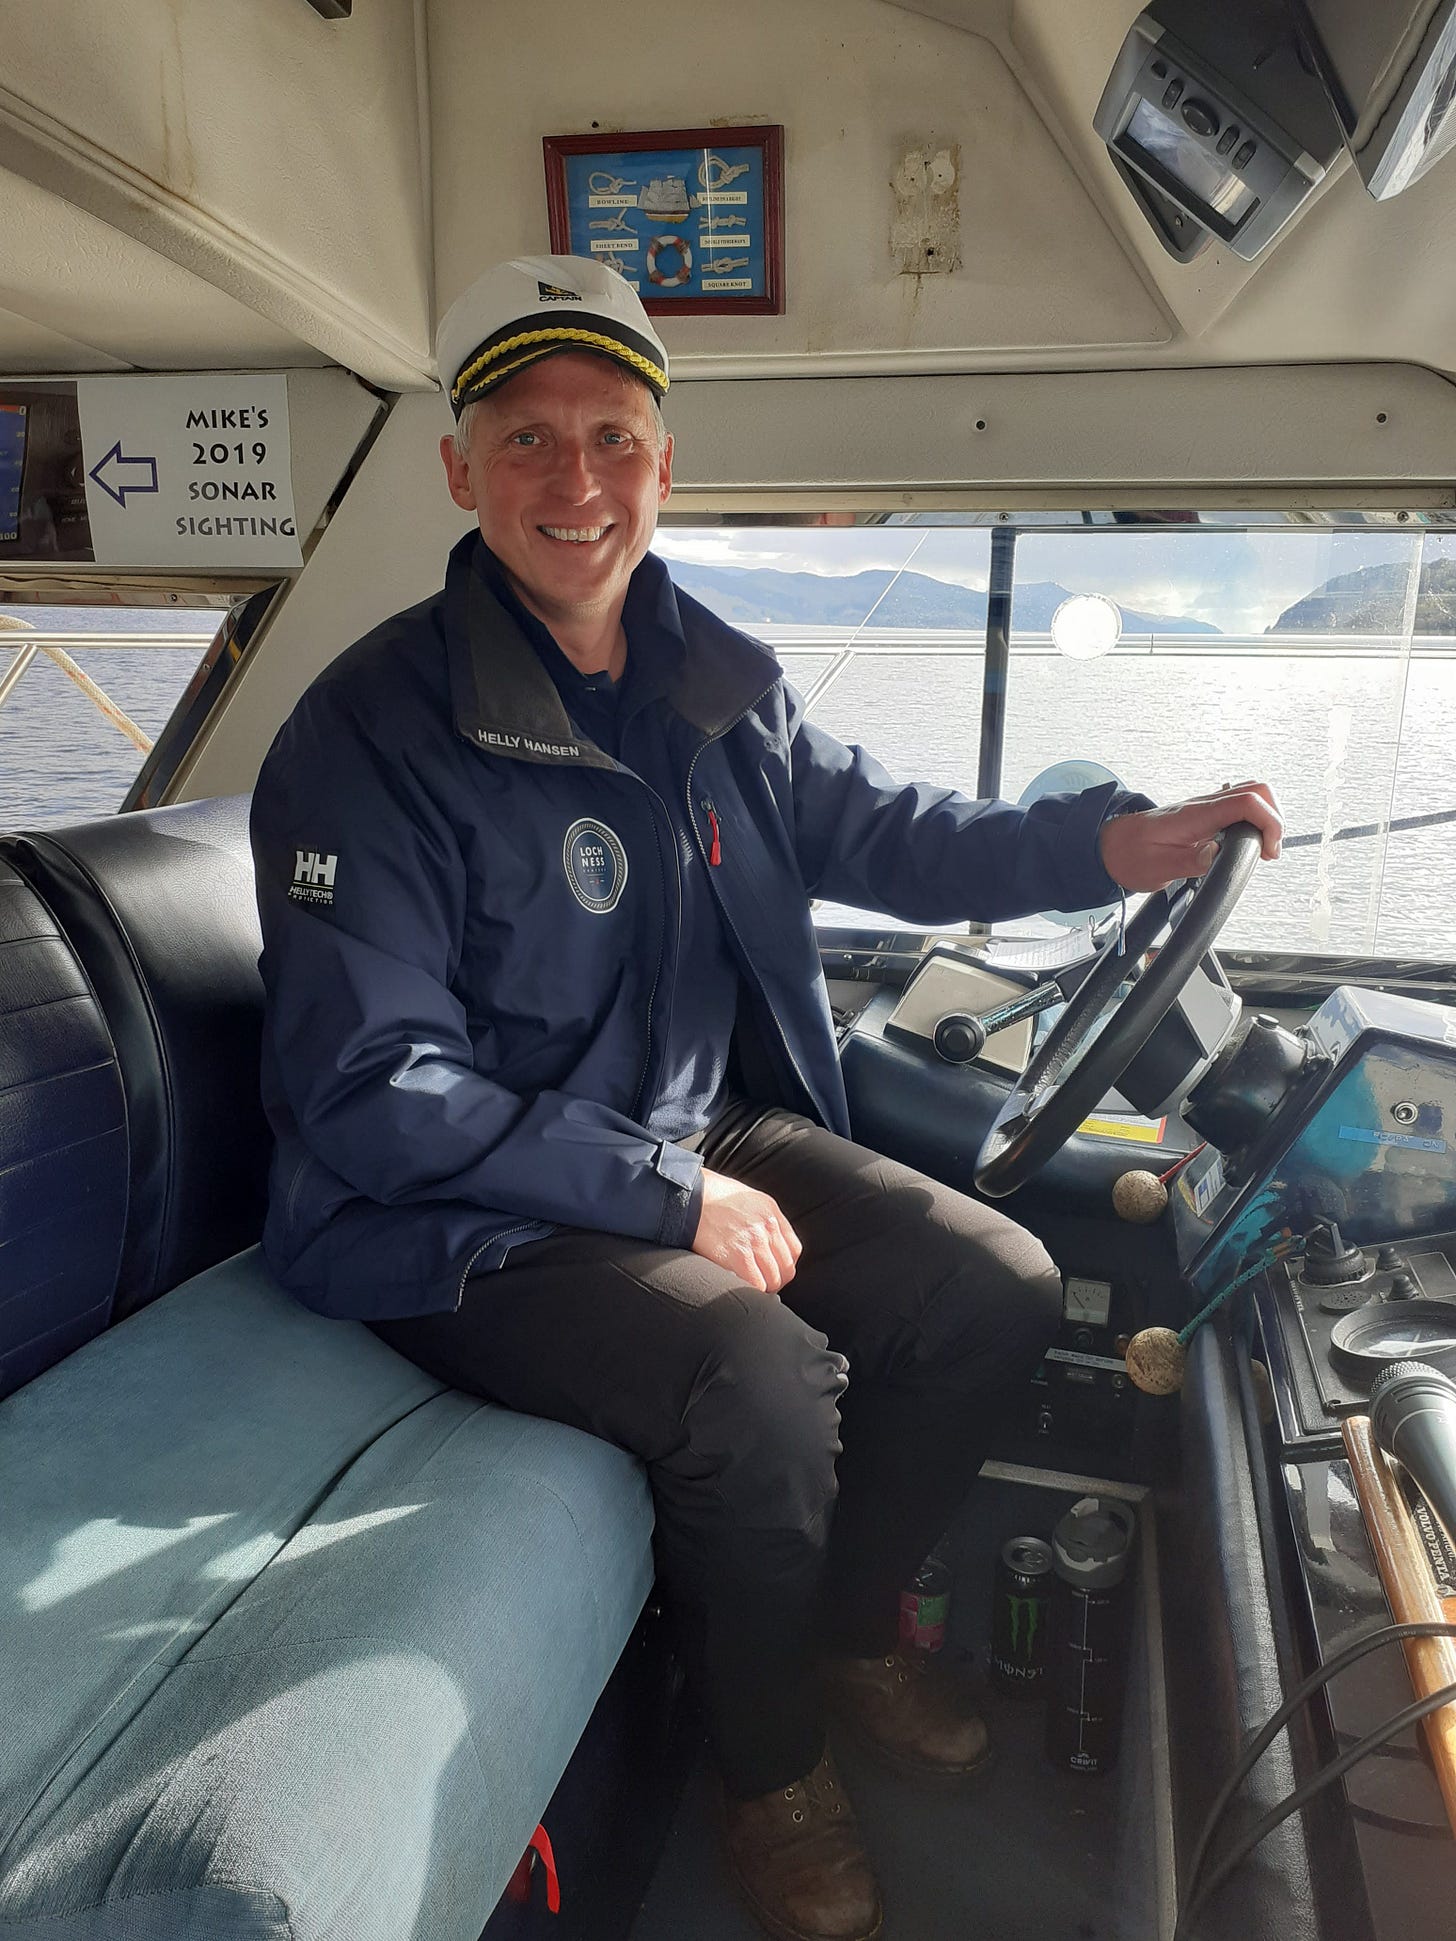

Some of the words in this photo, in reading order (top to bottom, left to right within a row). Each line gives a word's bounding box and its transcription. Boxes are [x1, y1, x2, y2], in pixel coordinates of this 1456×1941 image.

[185, 406, 269, 429] MIKE'S
[192, 443, 267, 465] 2019
[188, 481, 277, 501] SONAR
[176, 517, 296, 537] SIGHTING
[477, 729, 520, 748] HELLY
[524, 738, 580, 757] HANSEN
[579, 846, 603, 857] LOCH
[581, 857, 605, 868] NESS
[293, 850, 338, 886] HH
[1416, 1505, 1436, 1542] VOLVO
[1428, 1540, 1450, 1581] PENTA
